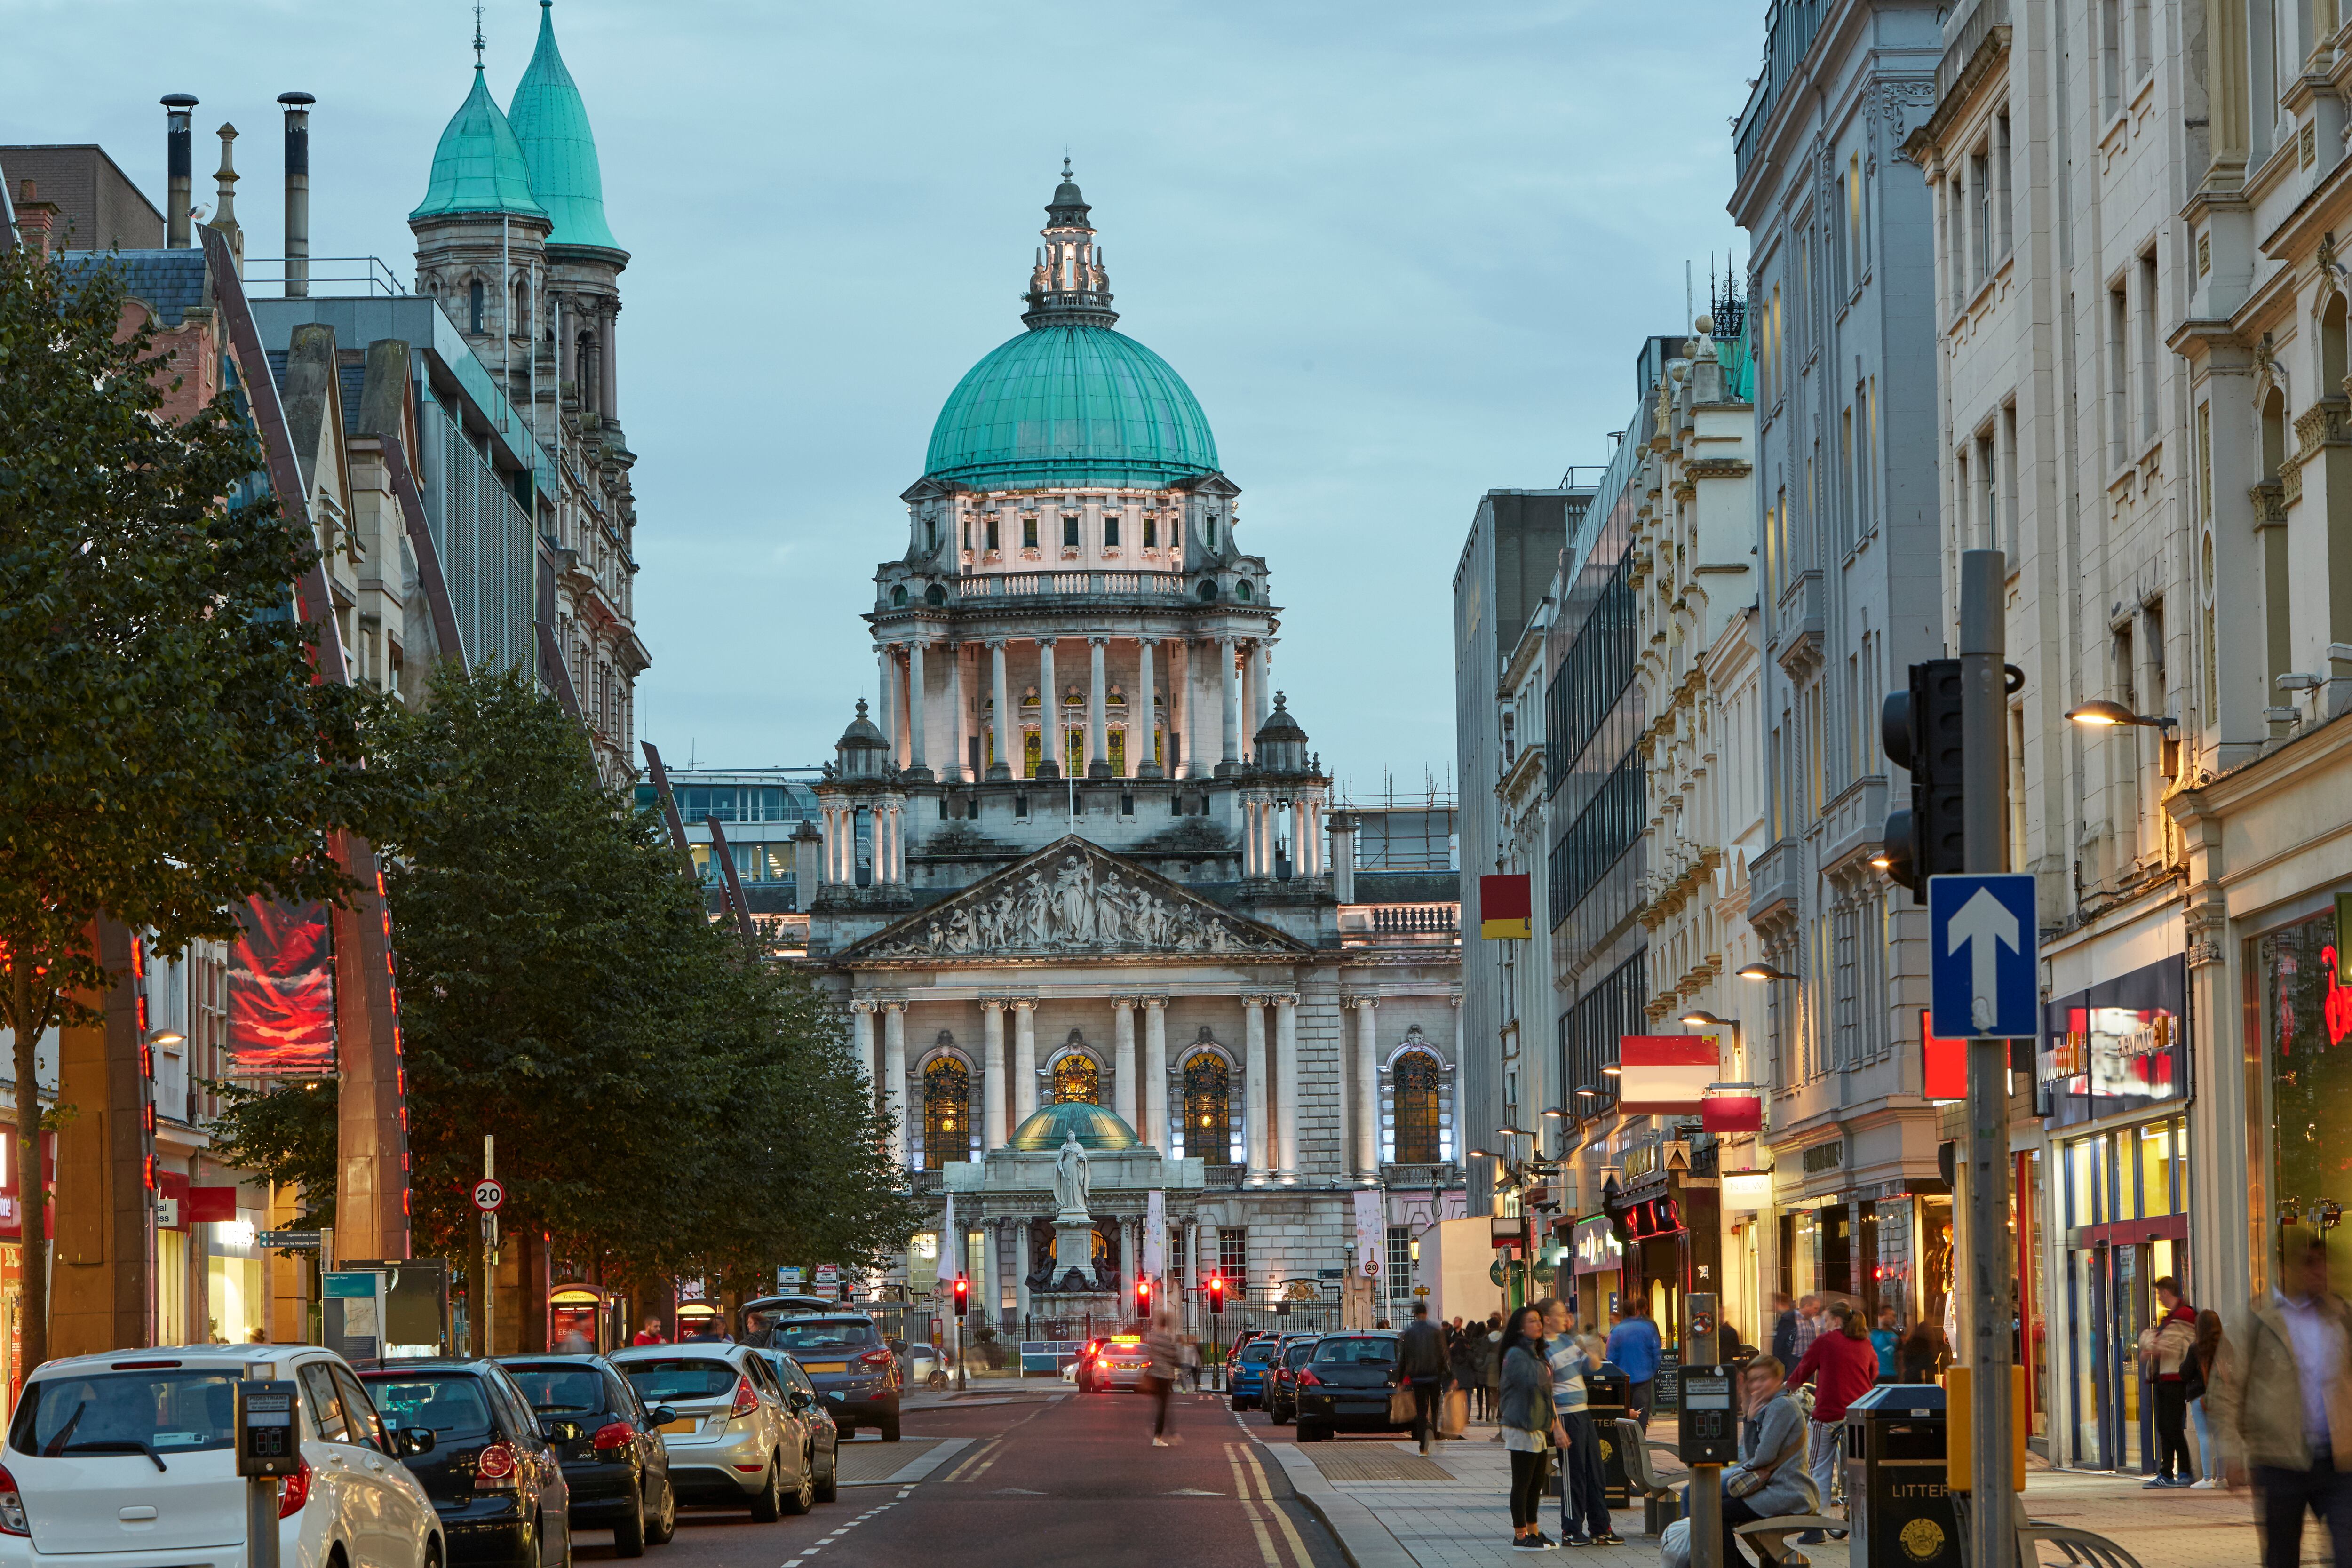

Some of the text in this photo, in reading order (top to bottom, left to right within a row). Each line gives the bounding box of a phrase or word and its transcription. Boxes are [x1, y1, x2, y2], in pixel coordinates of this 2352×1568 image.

[2037, 1031, 2078, 1084] poundworld
[477, 1189, 500, 1202] 20
[1892, 1485, 1950, 1497] LITTER
[1901, 1520, 1943, 1538] BELFAST
